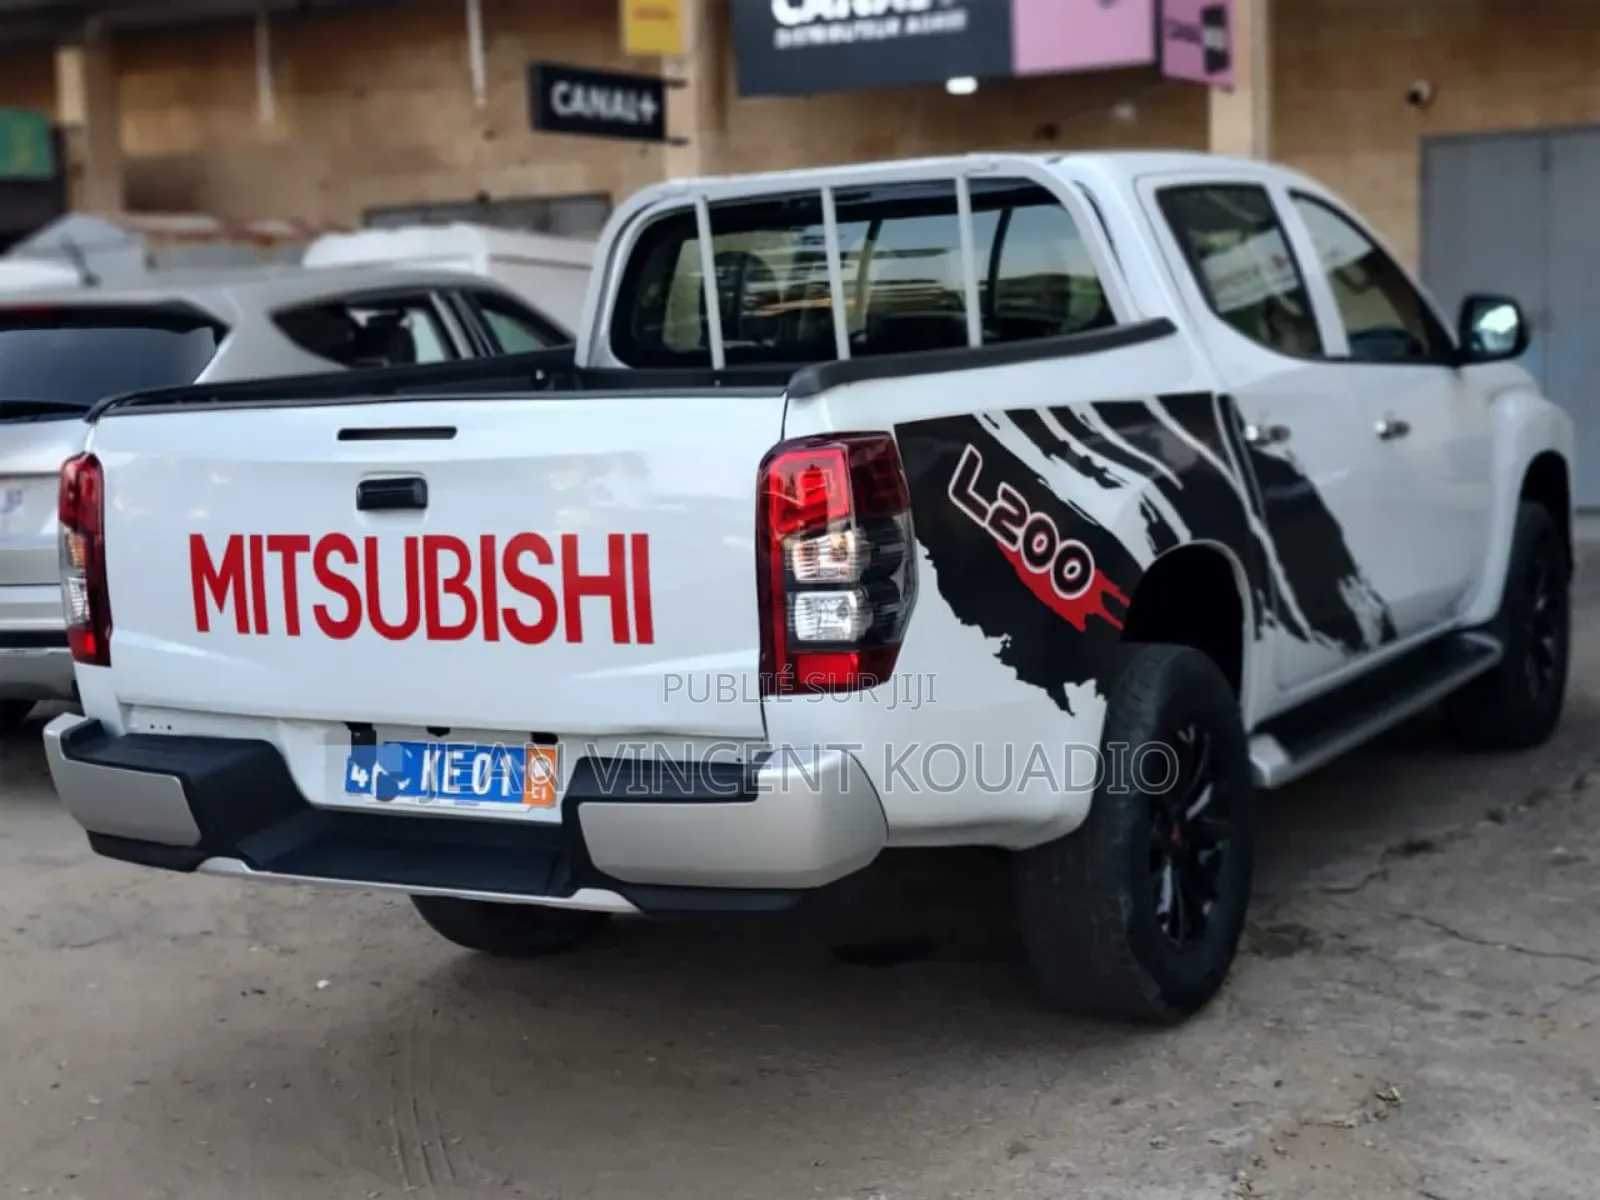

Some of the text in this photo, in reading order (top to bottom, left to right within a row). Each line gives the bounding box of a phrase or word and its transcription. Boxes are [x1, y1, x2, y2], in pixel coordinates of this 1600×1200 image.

[550, 79, 658, 124] CANAL+
[948, 443, 1096, 600] L200
[189, 531, 654, 645] MITSUBISHI
